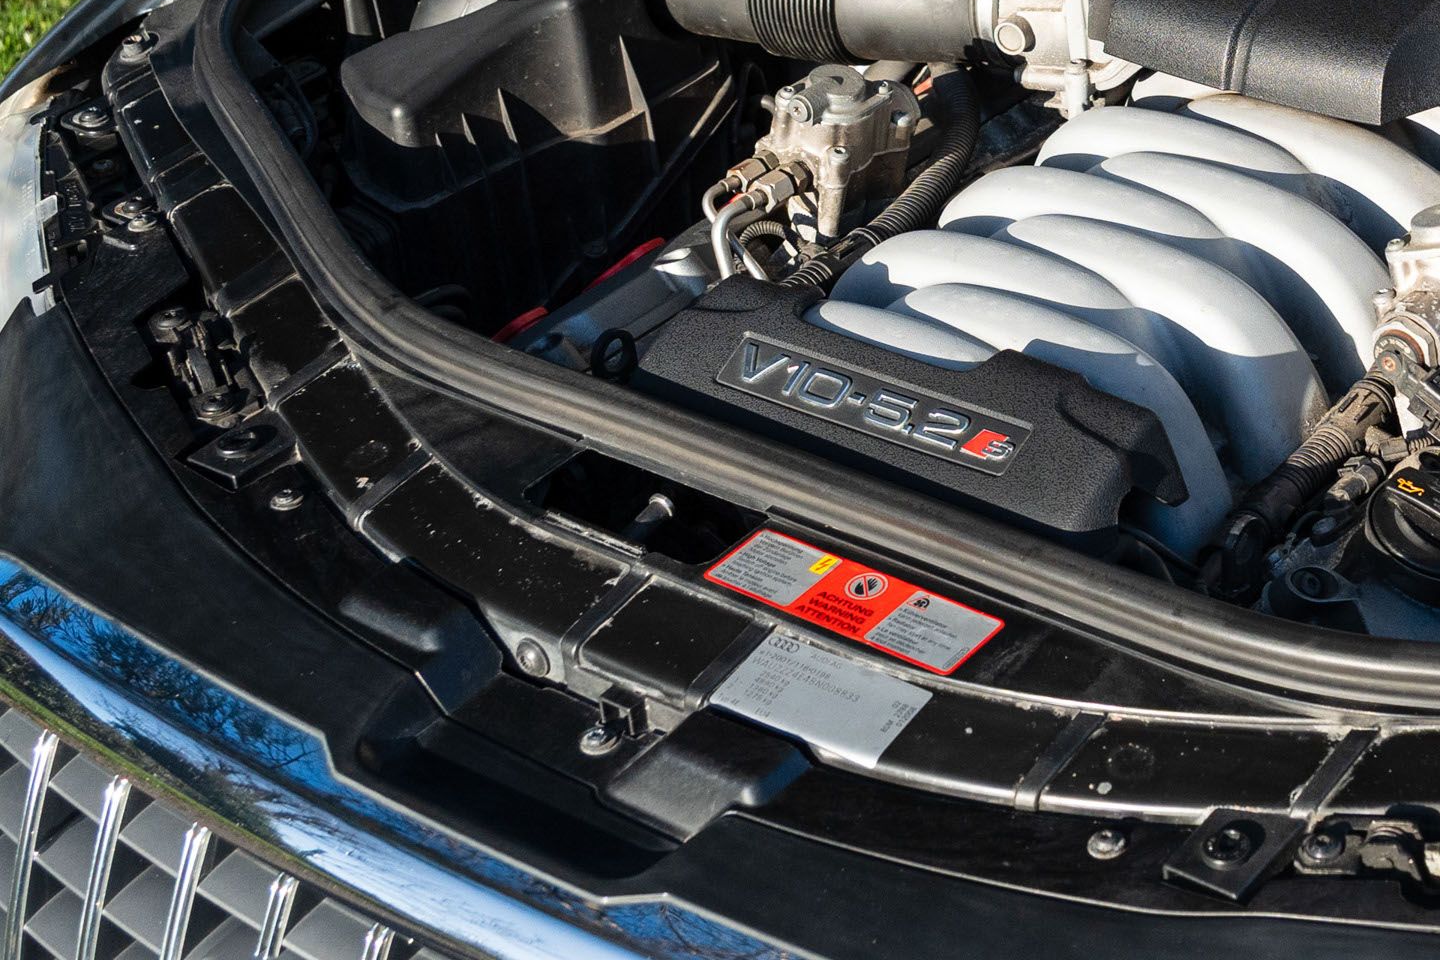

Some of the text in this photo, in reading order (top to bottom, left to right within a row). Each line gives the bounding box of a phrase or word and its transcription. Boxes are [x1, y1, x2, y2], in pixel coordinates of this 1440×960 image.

[795, 604, 861, 634] ATTENTION
[808, 597, 866, 626] WARNING
[817, 591, 875, 618] ACHTUNG
